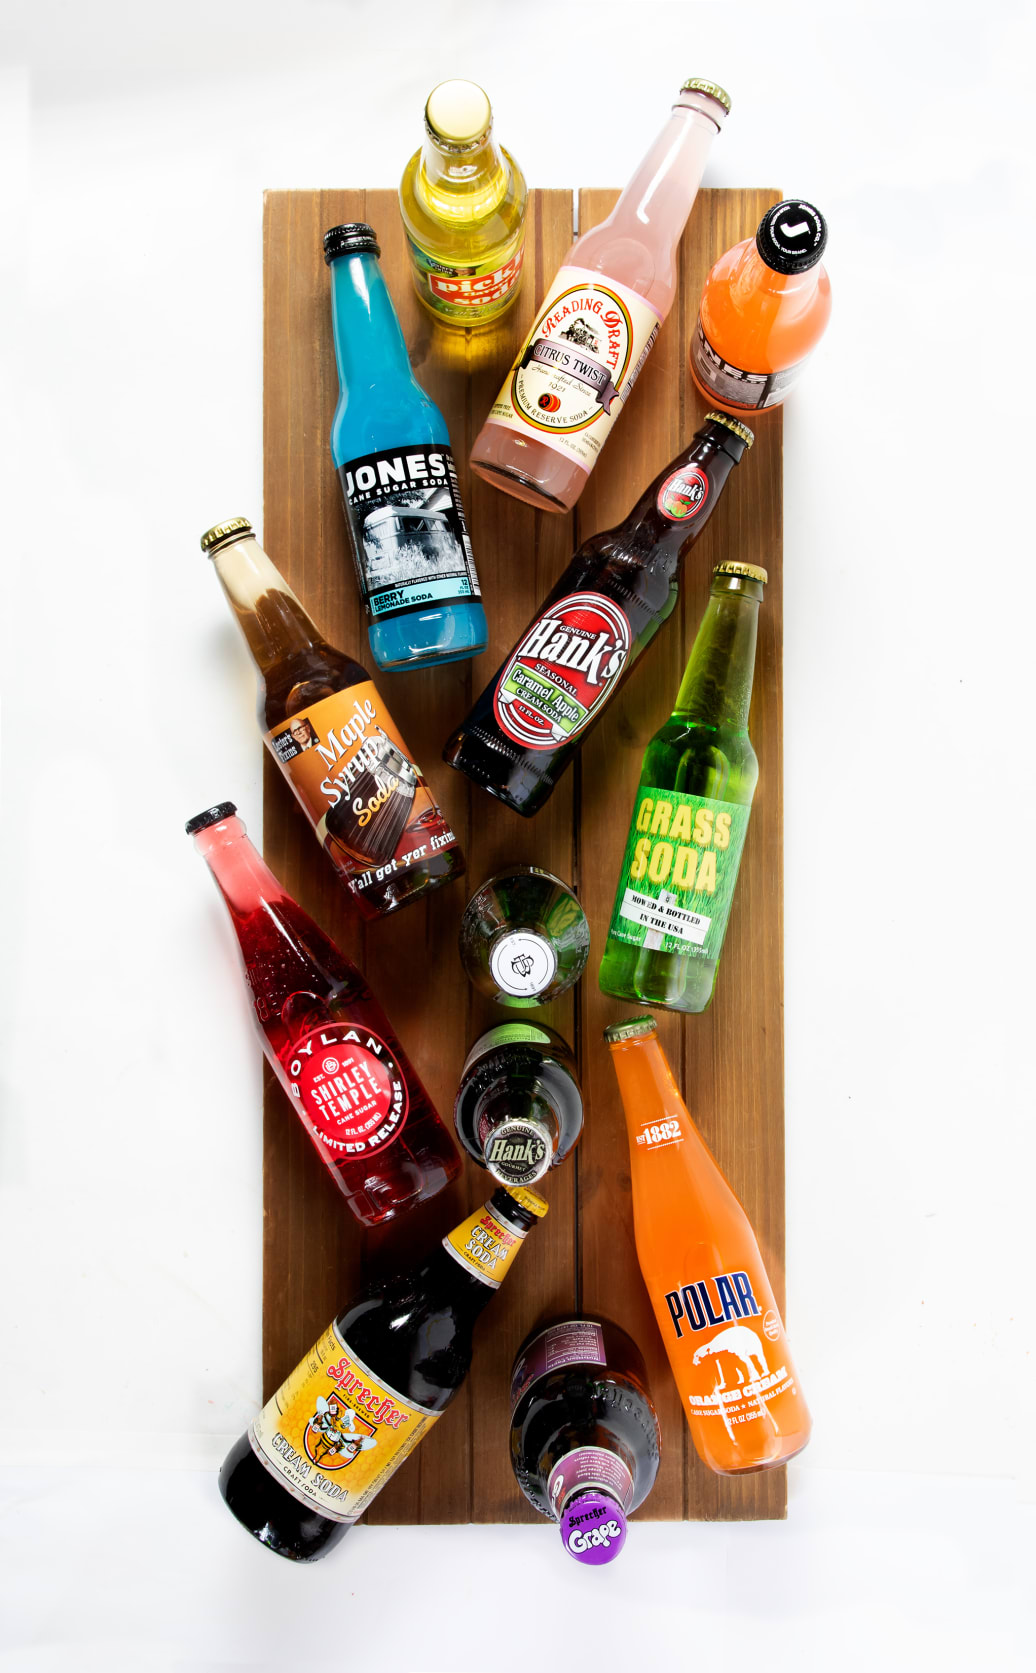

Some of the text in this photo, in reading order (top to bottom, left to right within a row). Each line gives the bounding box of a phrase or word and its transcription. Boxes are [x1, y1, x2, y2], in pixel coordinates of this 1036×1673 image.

[434, 247, 521, 293] pickl
[542, 298, 604, 338] READING
[600, 310, 624, 370] DRAFT
[533, 344, 606, 384] CITRUS TWIST
[548, 382, 566, 393] 1921
[531, 408, 568, 424] RESERVE
[570, 410, 588, 422] SODA
[346, 453, 446, 498] JONES
[667, 478, 704, 502] Hank's
[348, 478, 448, 506] CANE SUGAR SODA
[374, 590, 404, 606] BERRY
[375, 598, 410, 612] LEMONADE
[410, 593, 433, 602] SODA
[560, 625, 597, 640] GENUINE
[518, 618, 628, 684] Hank's
[512, 669, 580, 723] Caramel Apple
[534, 663, 578, 697] SEASONAL
[516, 687, 562, 724] CREAM SODA
[518, 705, 526, 713] 12
[524, 708, 534, 718] FL.
[315, 699, 376, 772] Maple
[320, 741, 381, 809] Syrup
[352, 775, 398, 827] Soda
[636, 797, 732, 850] GRASS
[348, 870, 372, 894] Y'all
[376, 858, 398, 882] get
[630, 838, 717, 896] SODA
[632, 894, 700, 926] MOWED & BOTTLED
[640, 913, 684, 935] IN THE USA
[666, 942, 672, 950] 12
[290, 1030, 382, 1098] BOYLAN
[313, 1073, 326, 1083] EST.
[310, 1061, 372, 1106] SHIRLEY
[318, 1077, 382, 1120] TEMPLE
[313, 1080, 403, 1152] LIMITED RELEASE
[337, 1100, 377, 1126] CANE SUGAR
[501, 1125, 535, 1136] GENUINE
[644, 1120, 682, 1144] 1882
[488, 1138, 546, 1164] Hank's
[501, 1161, 526, 1172] GOURMET
[496, 1169, 538, 1184] BEVERAGES
[471, 1225, 509, 1261] CREAM
[480, 1216, 517, 1247] Sprecher
[464, 1251, 476, 1264] CRAFT
[465, 1239, 498, 1270] SODA
[664, 1271, 761, 1339] POLAR
[326, 1356, 410, 1430] Sprecher
[688, 1366, 788, 1406] ORANGE CREAM
[703, 1408, 722, 1416] SUGAR
[732, 1416, 739, 1425] FL
[738, 1414, 746, 1424] OZ
[272, 1432, 312, 1480] CREAM
[310, 1472, 350, 1503] SODA
[283, 1466, 318, 1498] CRAFT SODA
[568, 1506, 607, 1528] Sprecher
[568, 1520, 622, 1554] Grape
